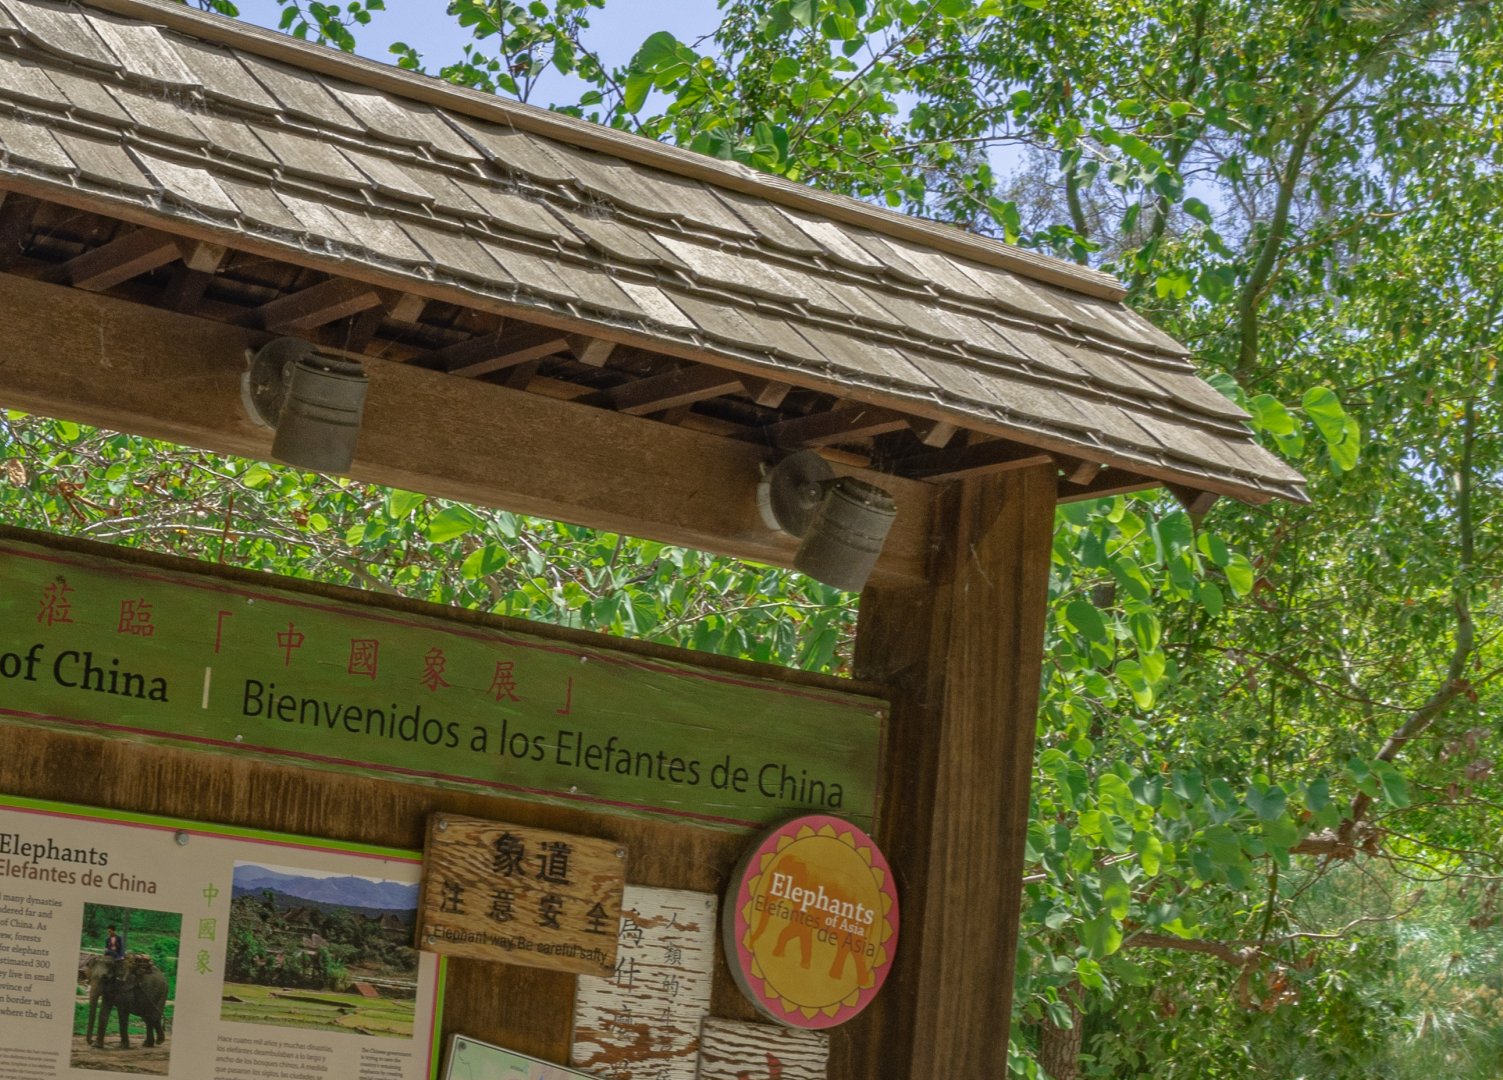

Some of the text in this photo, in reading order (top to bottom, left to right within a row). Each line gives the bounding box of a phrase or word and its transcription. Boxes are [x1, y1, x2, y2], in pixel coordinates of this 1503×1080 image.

[52, 650, 168, 702] China
[242, 678, 842, 808] Bienvenidos a los Elefantes de China
[492, 832, 573, 884] 象道
[80, 868, 102, 887] de
[107, 872, 156, 894] China
[2, 894, 25, 904] many
[25, 894, 62, 907] dynasties
[24, 906, 36, 916] far
[36, 909, 53, 918] and
[439, 881, 611, 936] 注意安全
[754, 894, 820, 928] Elefantes
[770, 872, 874, 925] Elephants
[0, 917, 9, 926] of
[9, 918, 35, 929] China.
[36, 921, 47, 930] As
[14, 931, 41, 942] forests
[825, 916, 864, 936] of Asia
[10, 943, 49, 956] elephants
[434, 924, 488, 945] Elephant
[517, 936, 533, 951] Be
[537, 943, 577, 958] careful
[817, 928, 875, 957] de Asia
[34, 959, 50, 968] 300
